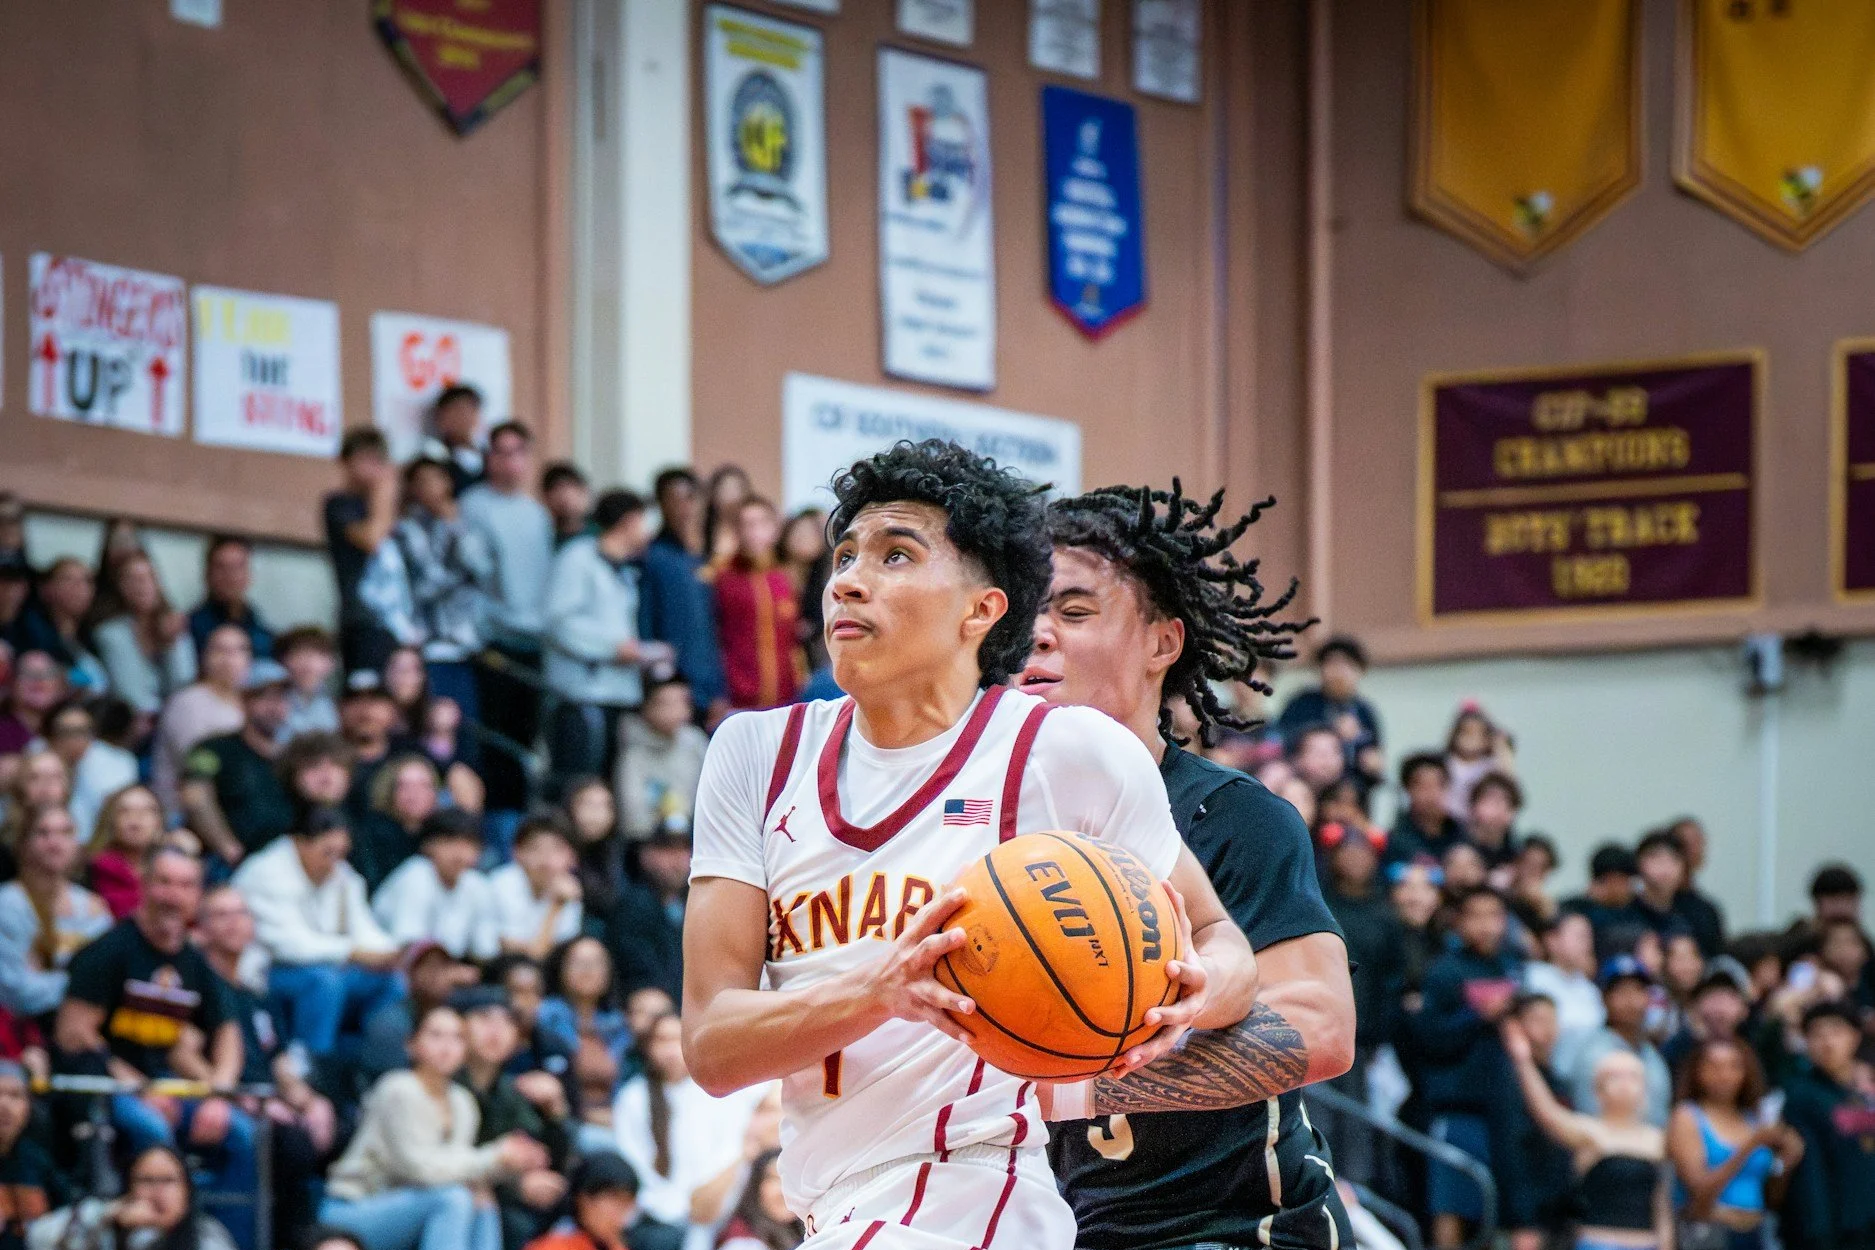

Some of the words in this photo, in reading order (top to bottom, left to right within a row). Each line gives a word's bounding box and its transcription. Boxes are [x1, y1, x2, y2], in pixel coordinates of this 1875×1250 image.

[67, 348, 136, 416] UP
[771, 871, 937, 959] XNAR
[1024, 860, 1096, 938] EVO
